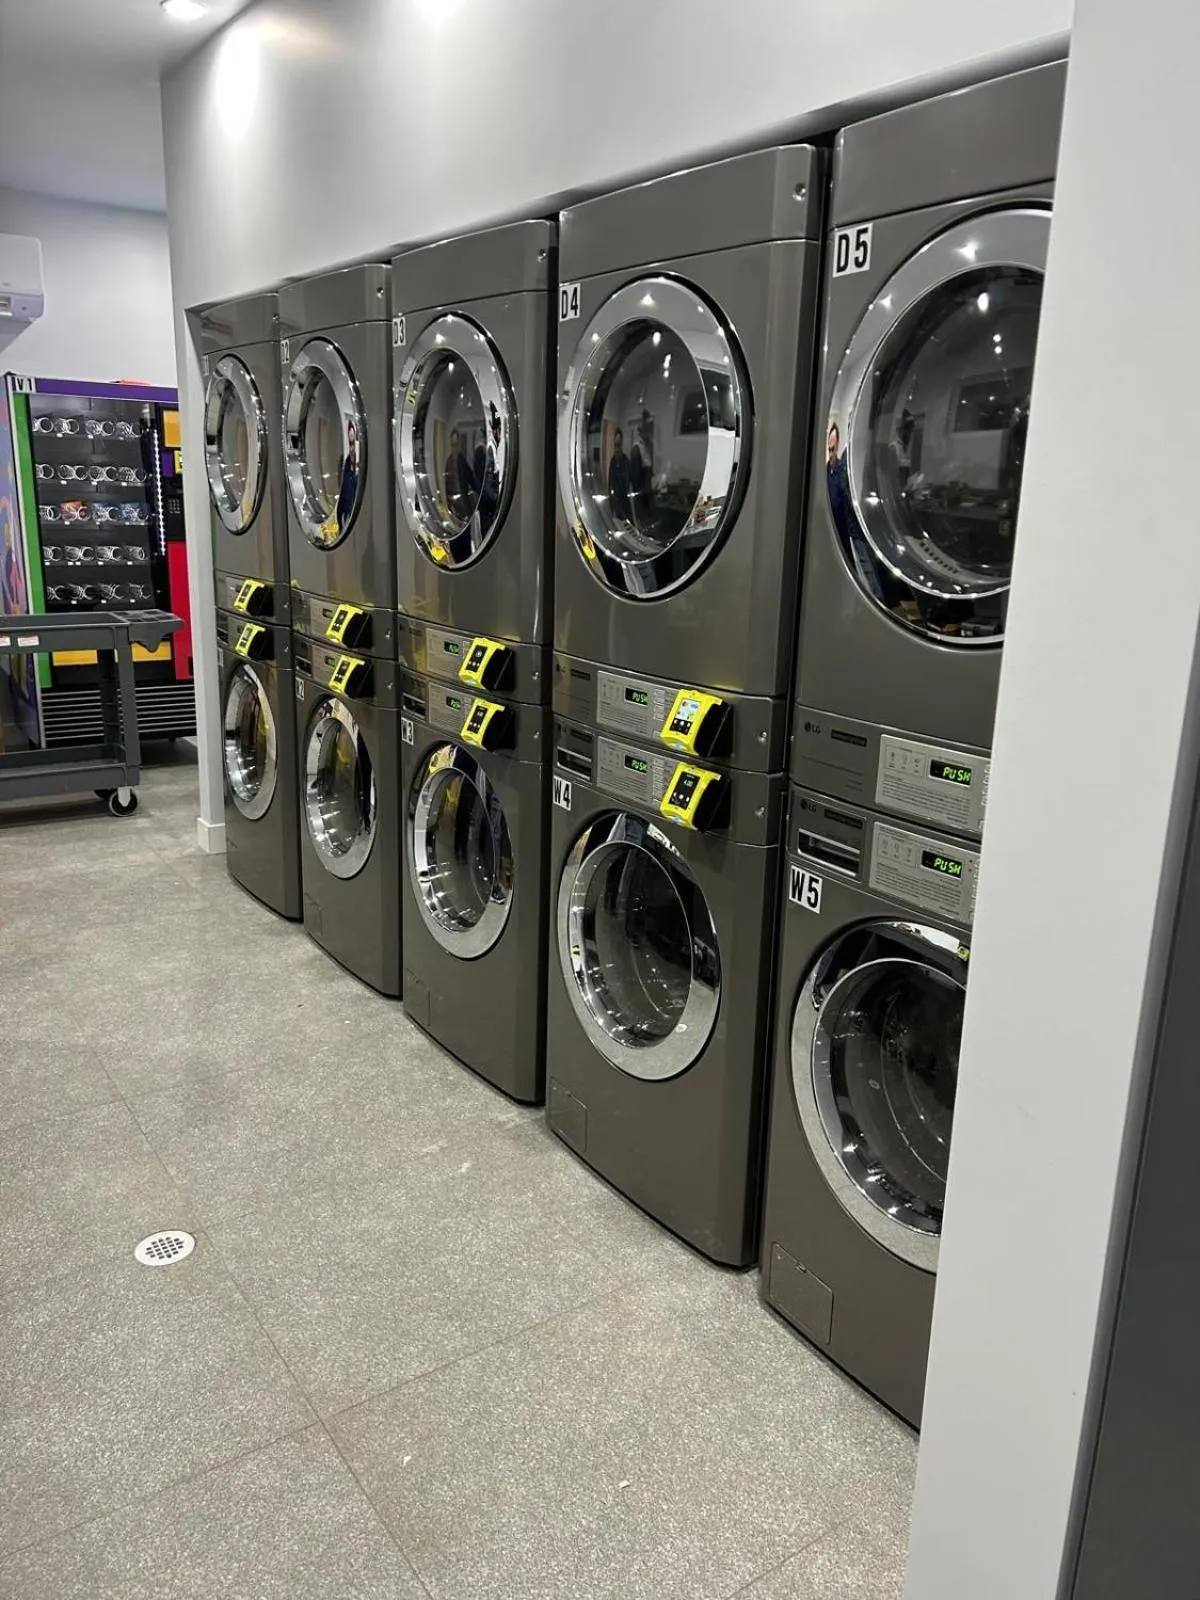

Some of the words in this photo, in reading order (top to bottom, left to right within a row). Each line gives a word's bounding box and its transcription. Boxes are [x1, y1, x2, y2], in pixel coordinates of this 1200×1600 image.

[837, 227, 869, 273] D5
[561, 286, 579, 319] D4
[942, 766, 972, 782] PUSH
[554, 778, 570, 809] W4
[933, 857, 962, 875] PUSH
[791, 868, 820, 909] W5
